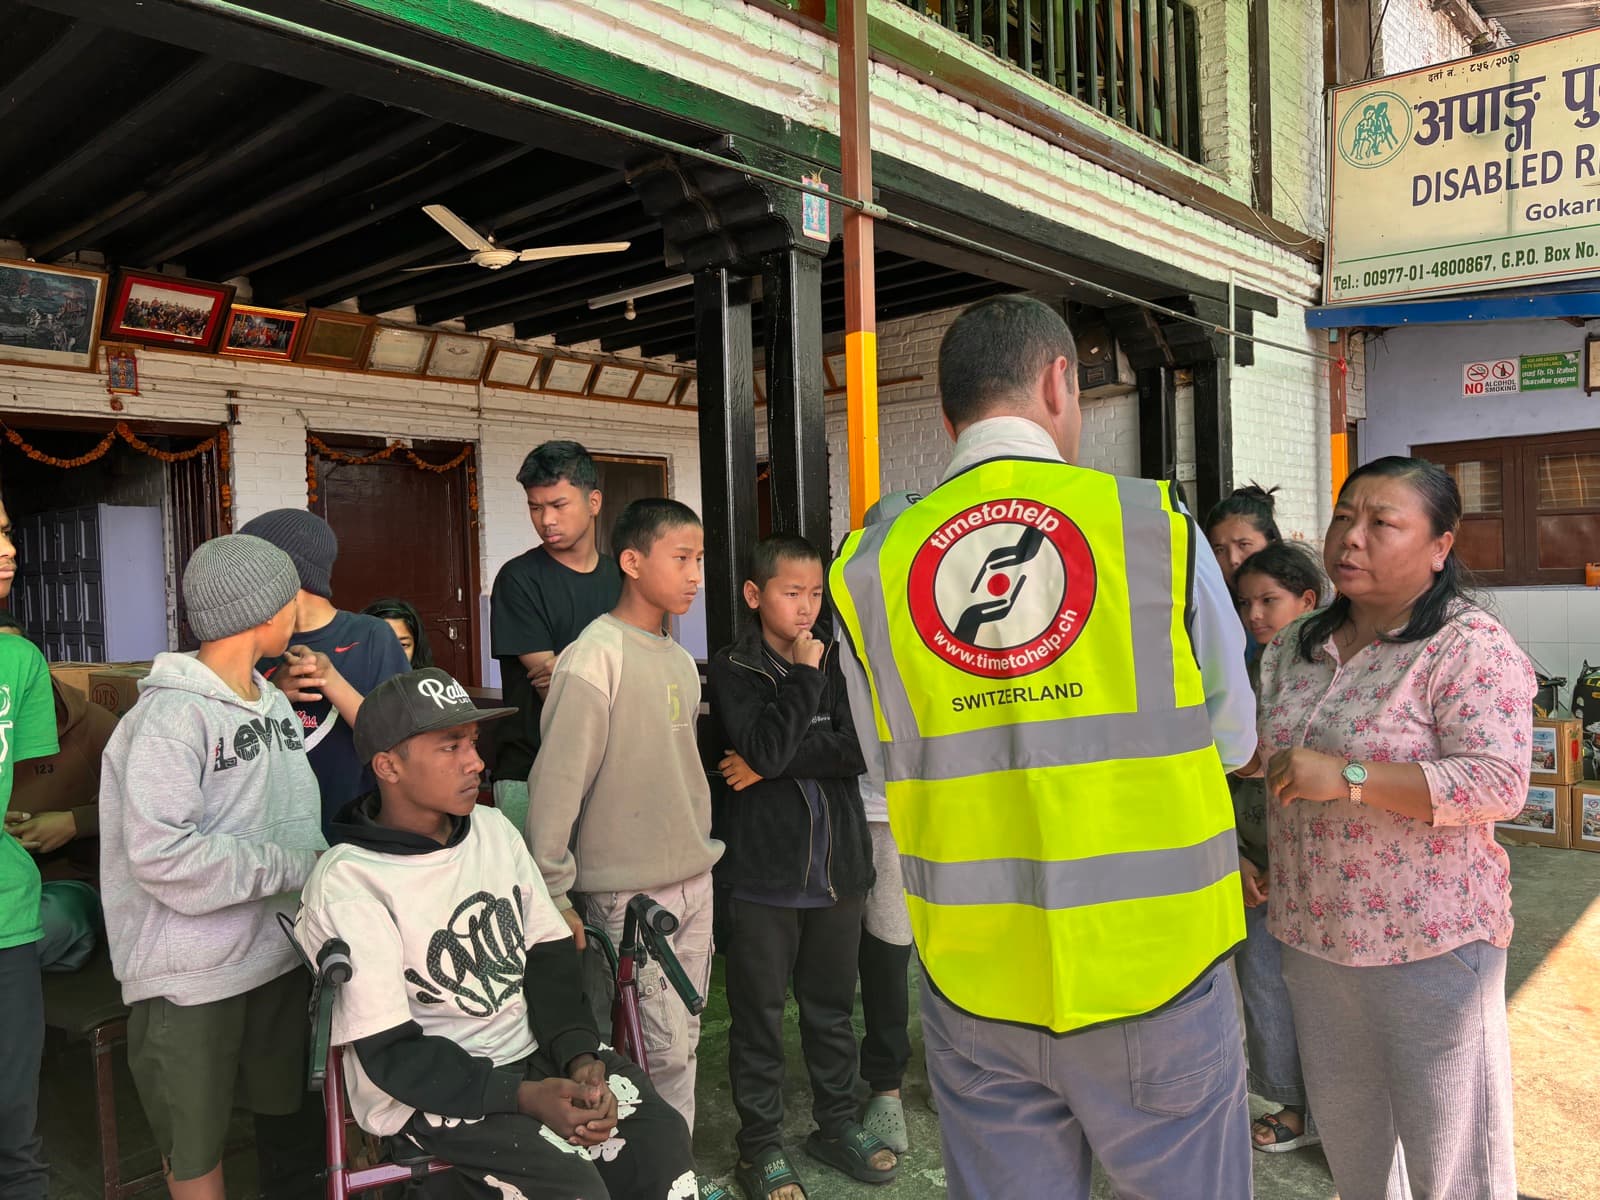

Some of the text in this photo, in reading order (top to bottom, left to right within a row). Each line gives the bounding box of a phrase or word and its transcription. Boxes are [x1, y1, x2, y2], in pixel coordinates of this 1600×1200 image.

[1562, 63, 1600, 128] पु
[1411, 143, 1600, 207] DISABLED R
[1333, 241, 1599, 291] Tel.: 00977-01-4800867, G.P.O. Box No.
[1464, 382, 1484, 395] NO
[1485, 379, 1517, 388] ALCOHOL
[1485, 384, 1517, 393] SMOKING
[930, 500, 1060, 551] timetohelp
[933, 608, 1078, 671] www.timetohelp.ch
[951, 682, 1084, 712] SWITZERLAND
[764, 1159, 786, 1175] PEACE
